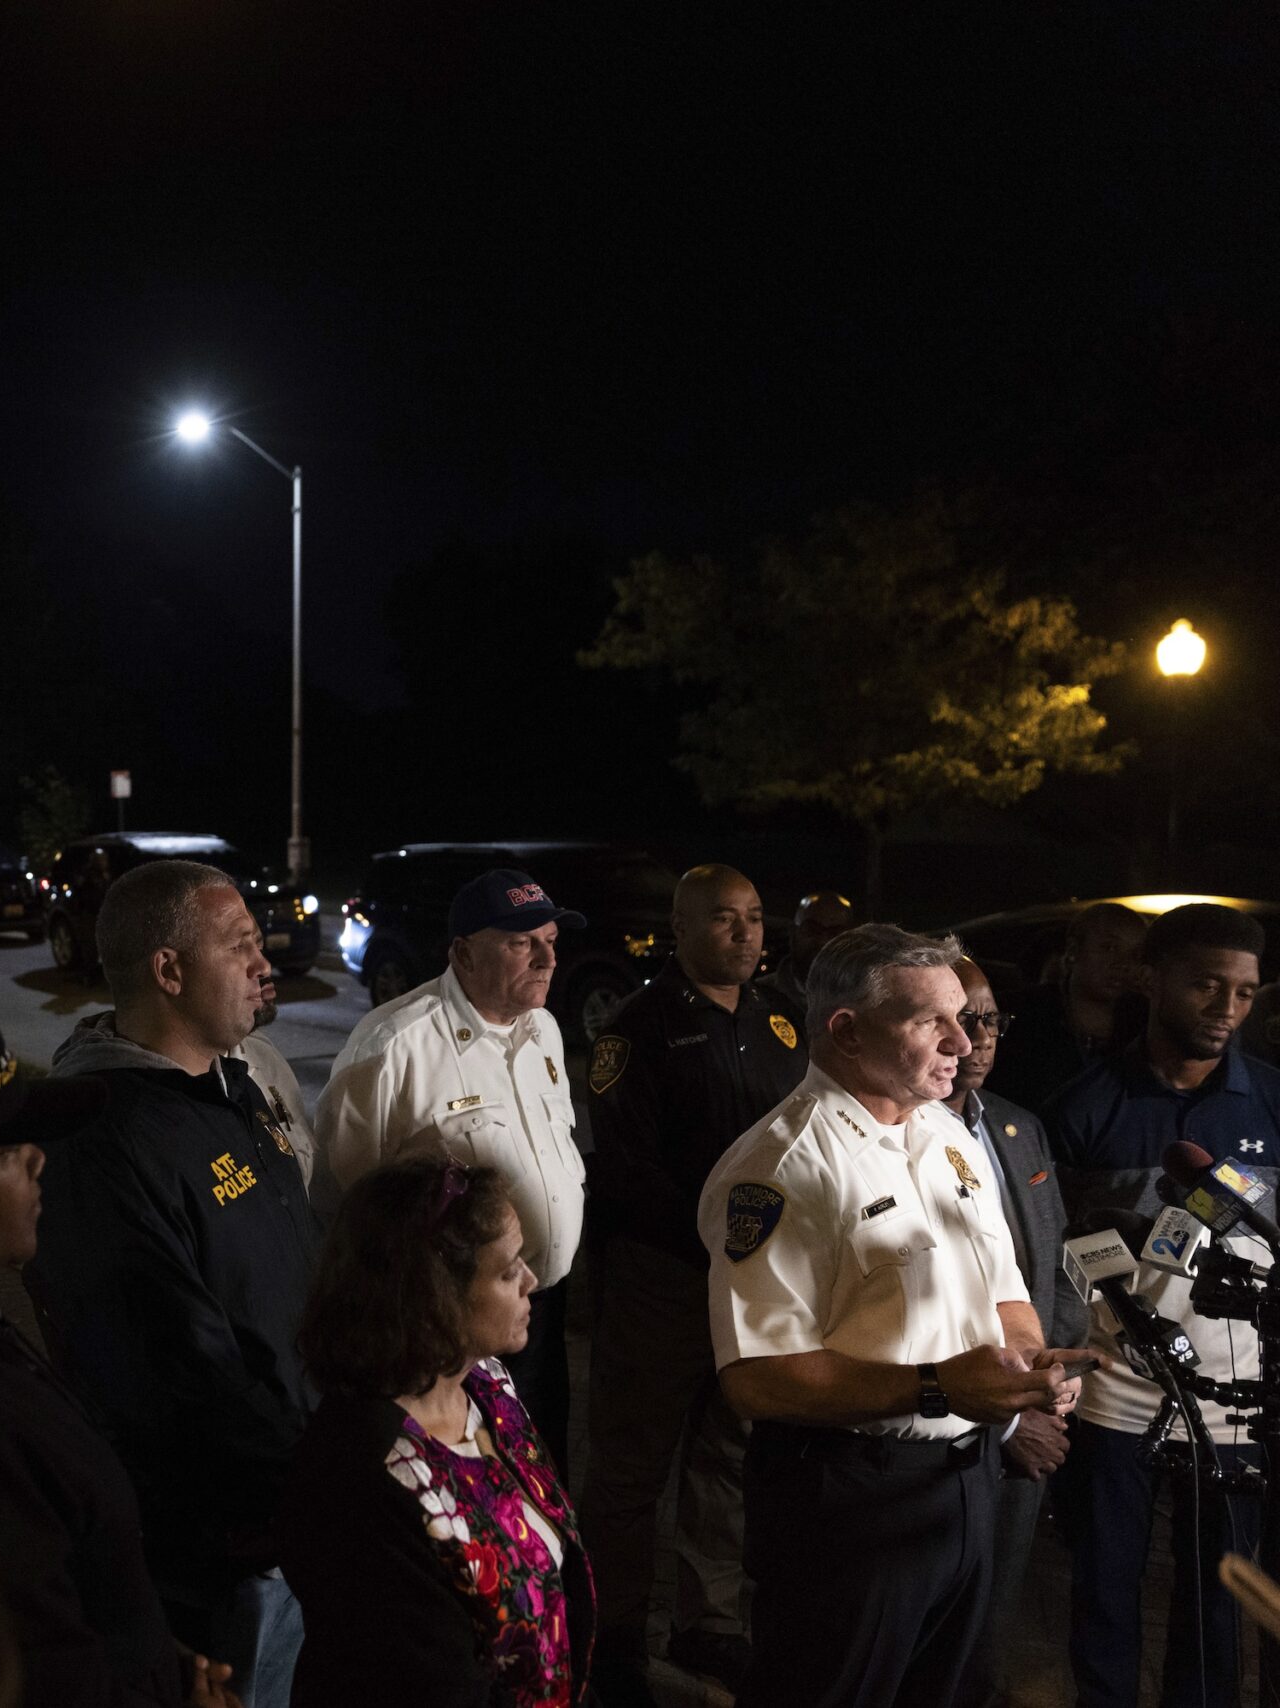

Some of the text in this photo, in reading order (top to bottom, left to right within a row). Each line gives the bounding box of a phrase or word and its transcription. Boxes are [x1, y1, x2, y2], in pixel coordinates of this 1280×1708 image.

[210, 1151, 239, 1181] ATF
[211, 1164, 258, 1206] POLICE
[734, 1195, 768, 1210] POLICE
[1100, 1243, 1123, 1253] NEWS
